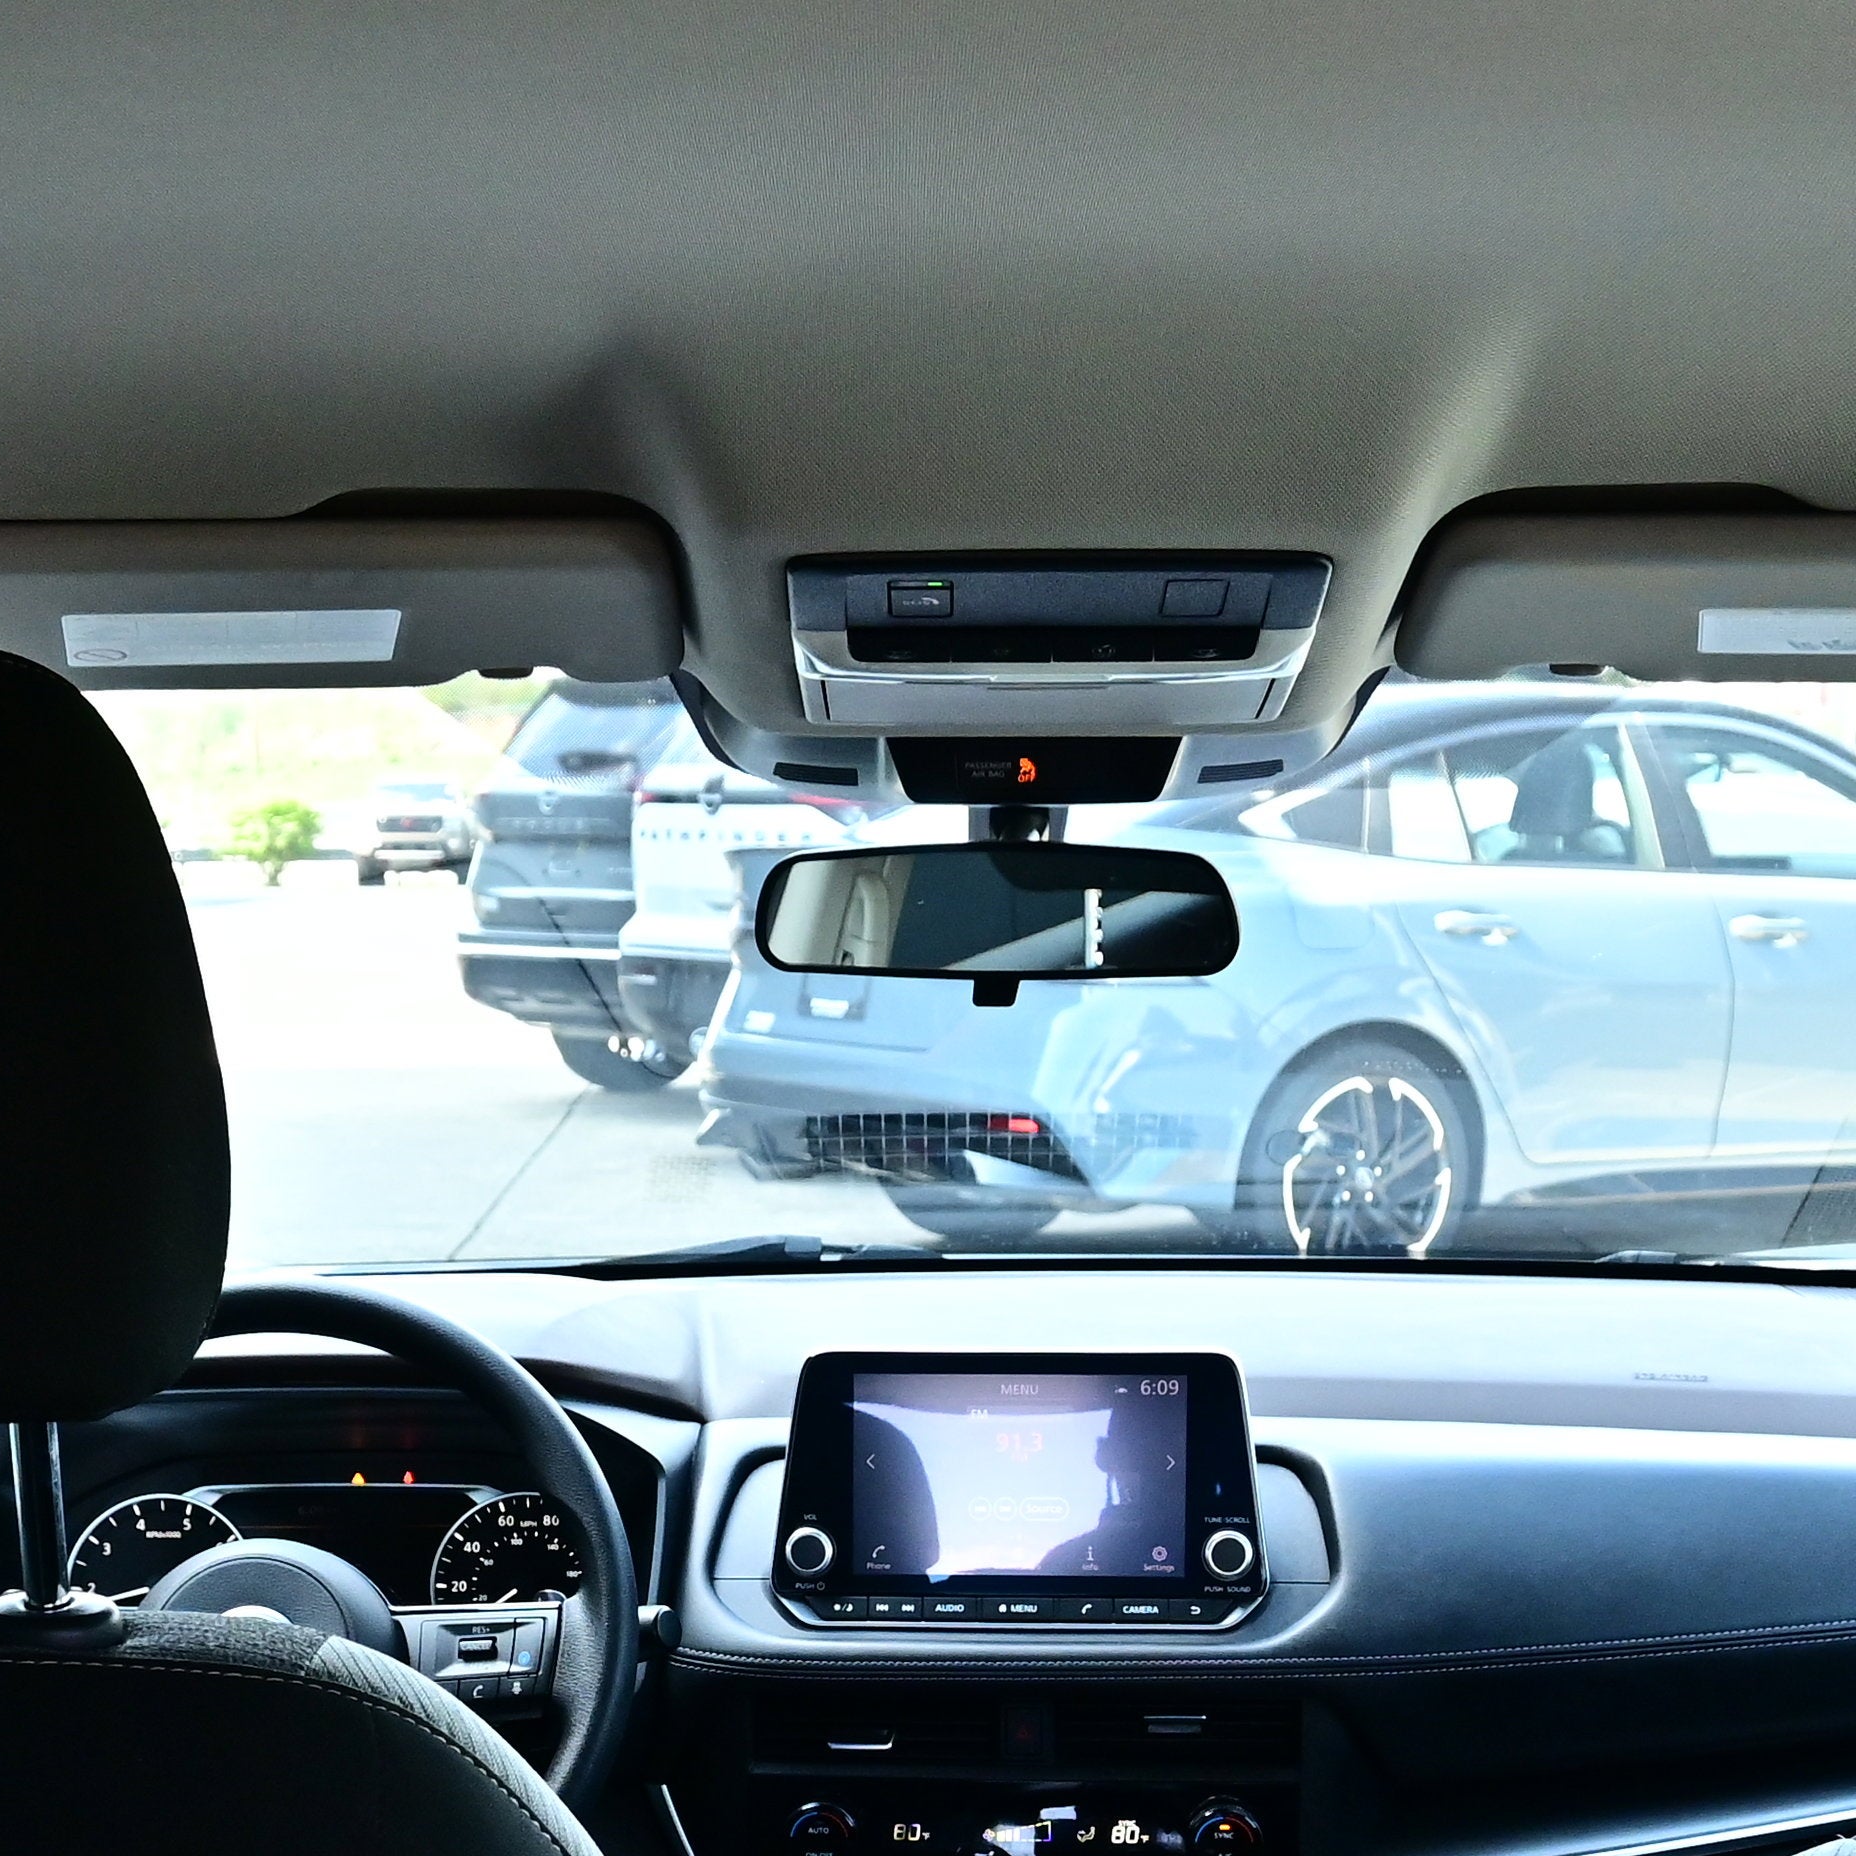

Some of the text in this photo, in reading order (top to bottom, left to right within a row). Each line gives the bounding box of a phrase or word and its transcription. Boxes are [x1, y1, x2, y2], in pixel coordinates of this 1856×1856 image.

[1000, 1384, 1039, 1395] MENU
[1140, 1380, 1179, 1395] 6:09
[135, 1518, 146, 1531] 4
[182, 1517, 192, 1531] 5
[498, 1515, 515, 1527] 60
[542, 1515, 560, 1526] 80
[101, 1541, 112, 1556] 3
[463, 1541, 481, 1553] 40
[1143, 1563, 1175, 1573] Settings
[450, 1580, 468, 1593] 20
[935, 1603, 964, 1613] AUDIO
[1010, 1604, 1038, 1613] MENU
[1122, 1605, 1159, 1614] CAMERA
